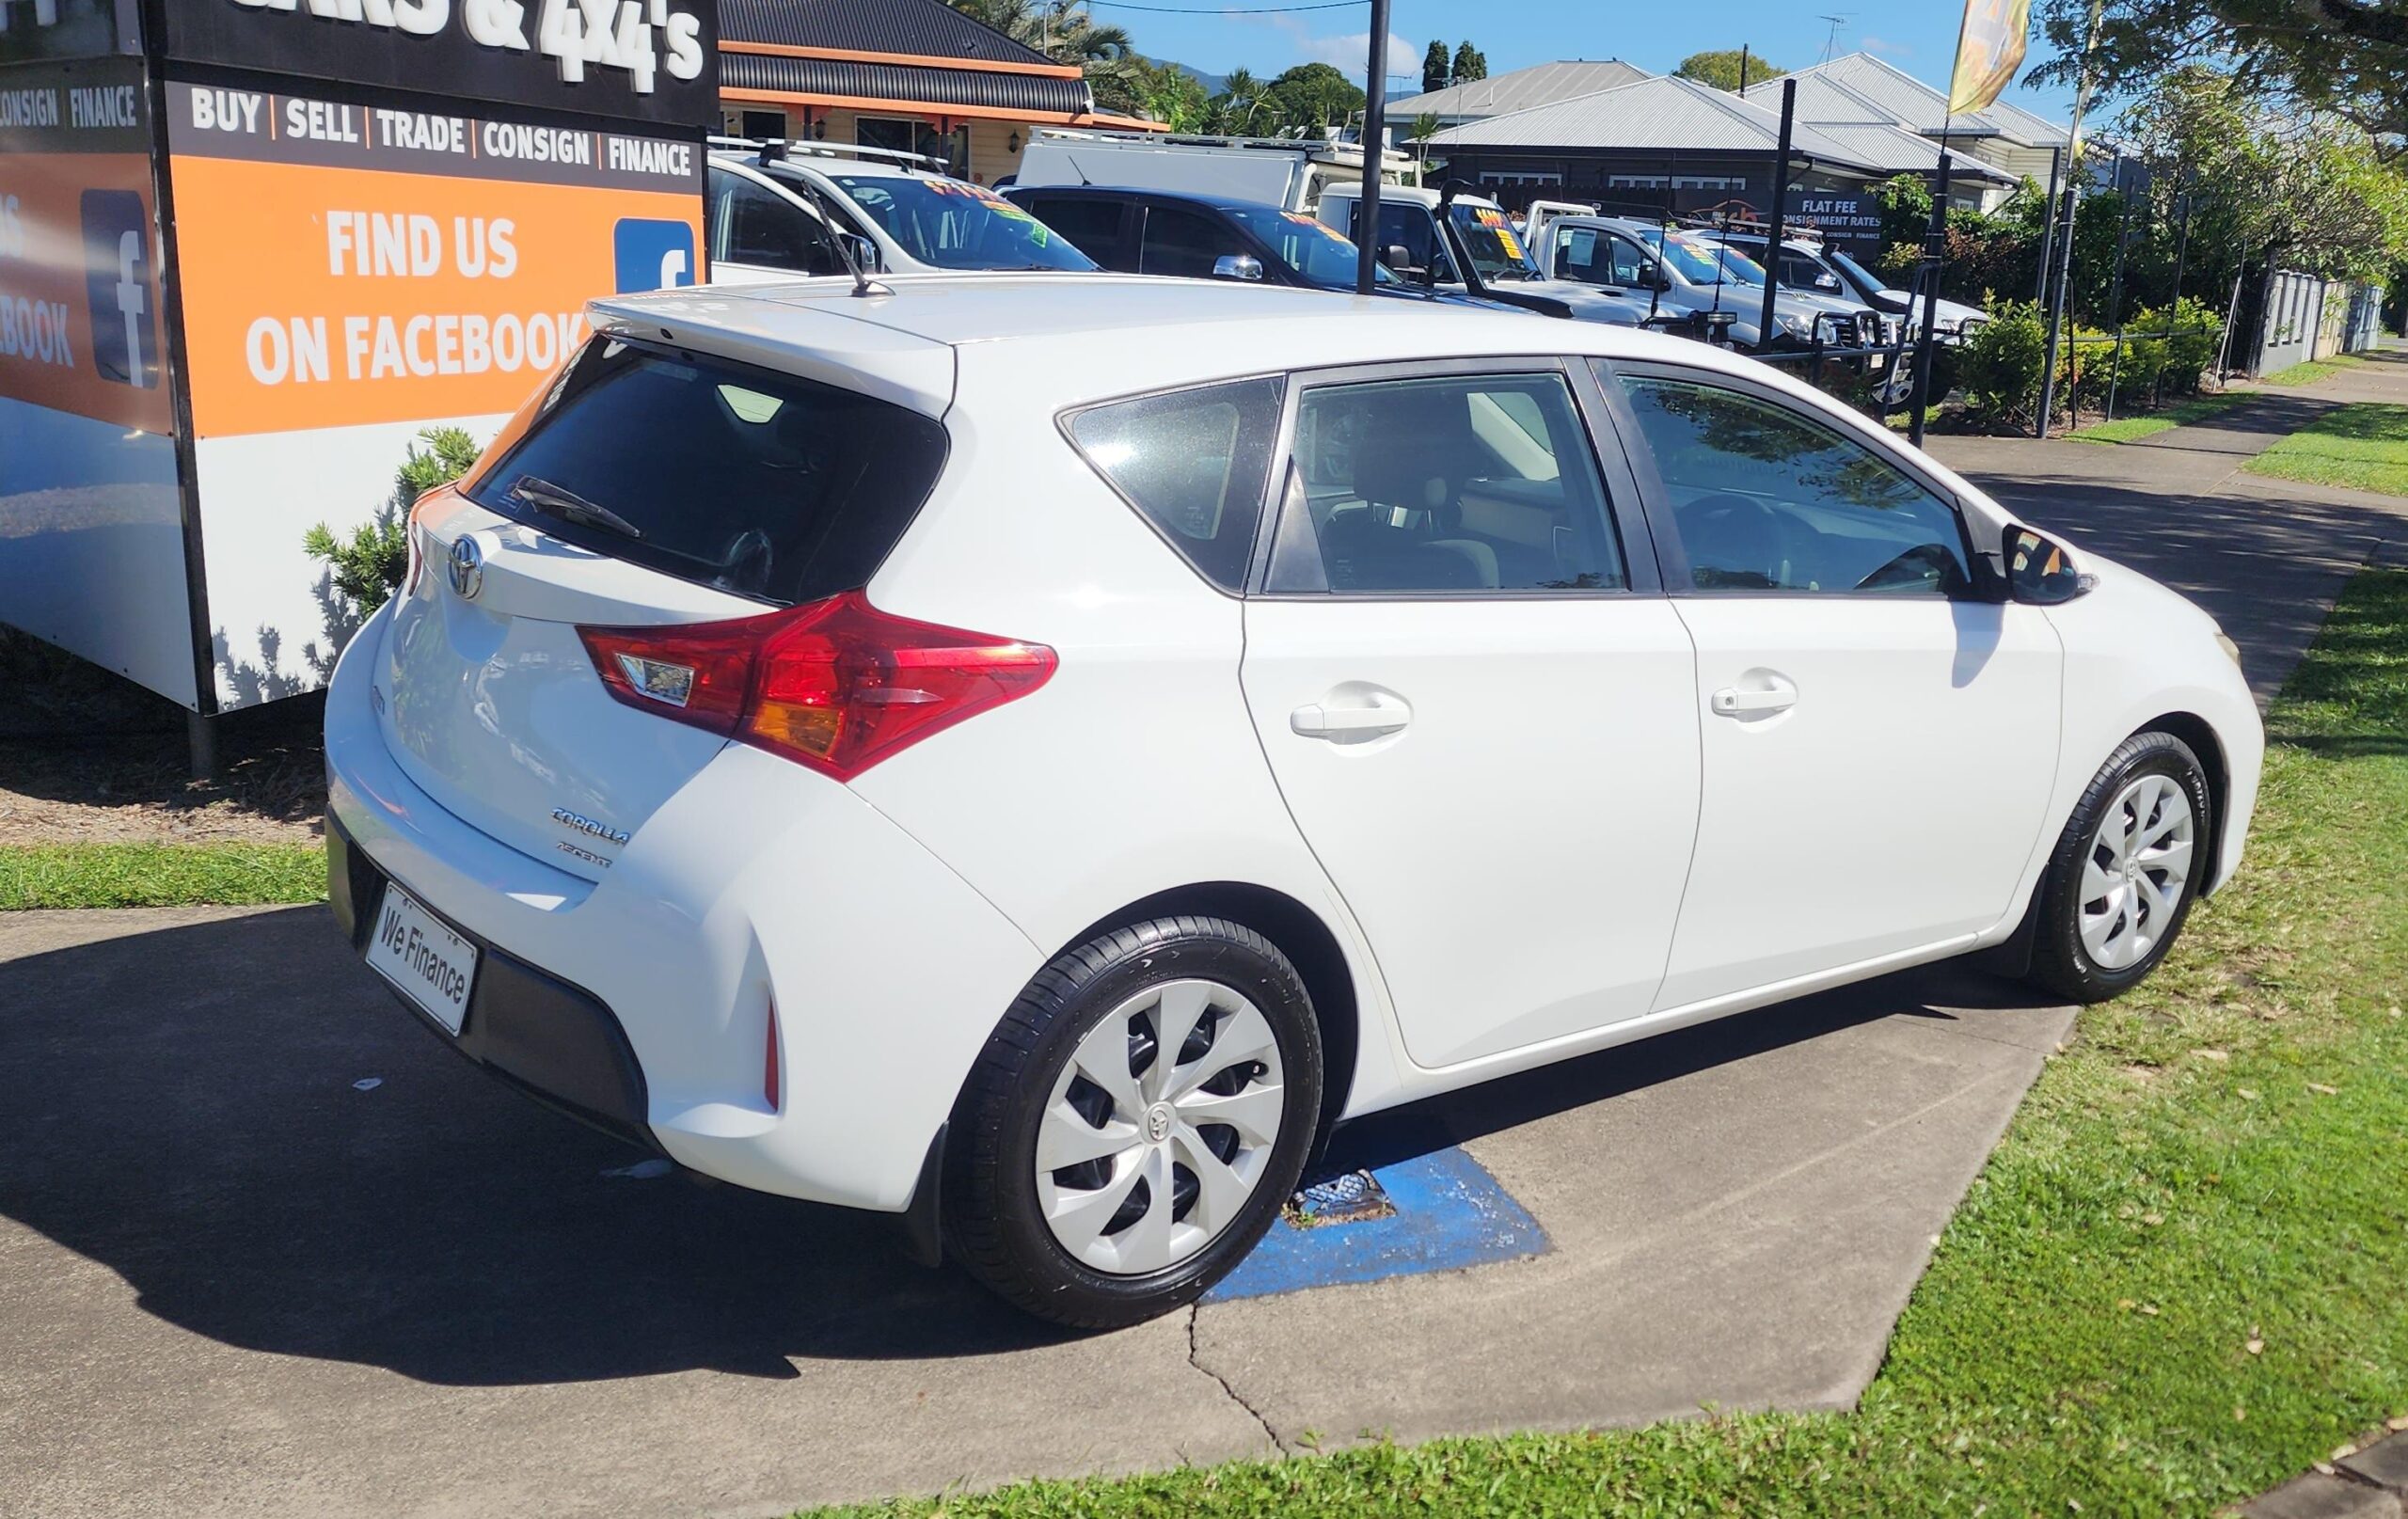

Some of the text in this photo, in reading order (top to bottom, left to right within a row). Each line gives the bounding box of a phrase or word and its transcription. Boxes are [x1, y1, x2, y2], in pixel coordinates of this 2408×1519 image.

[0, 85, 137, 128] ONSIGN FINANCE
[191, 87, 691, 177] BUY SELL TRADE CONSIGN FINANCE
[1782, 214, 1882, 228] ONSIGNMENT RATES
[1802, 199, 1858, 214] FLAT FEE
[325, 209, 519, 278] FIND US
[246, 316, 330, 386] ON
[344, 311, 586, 380] FACEBOOK
[549, 807, 630, 847] COROLLA
[380, 905, 466, 1005] We Finance
